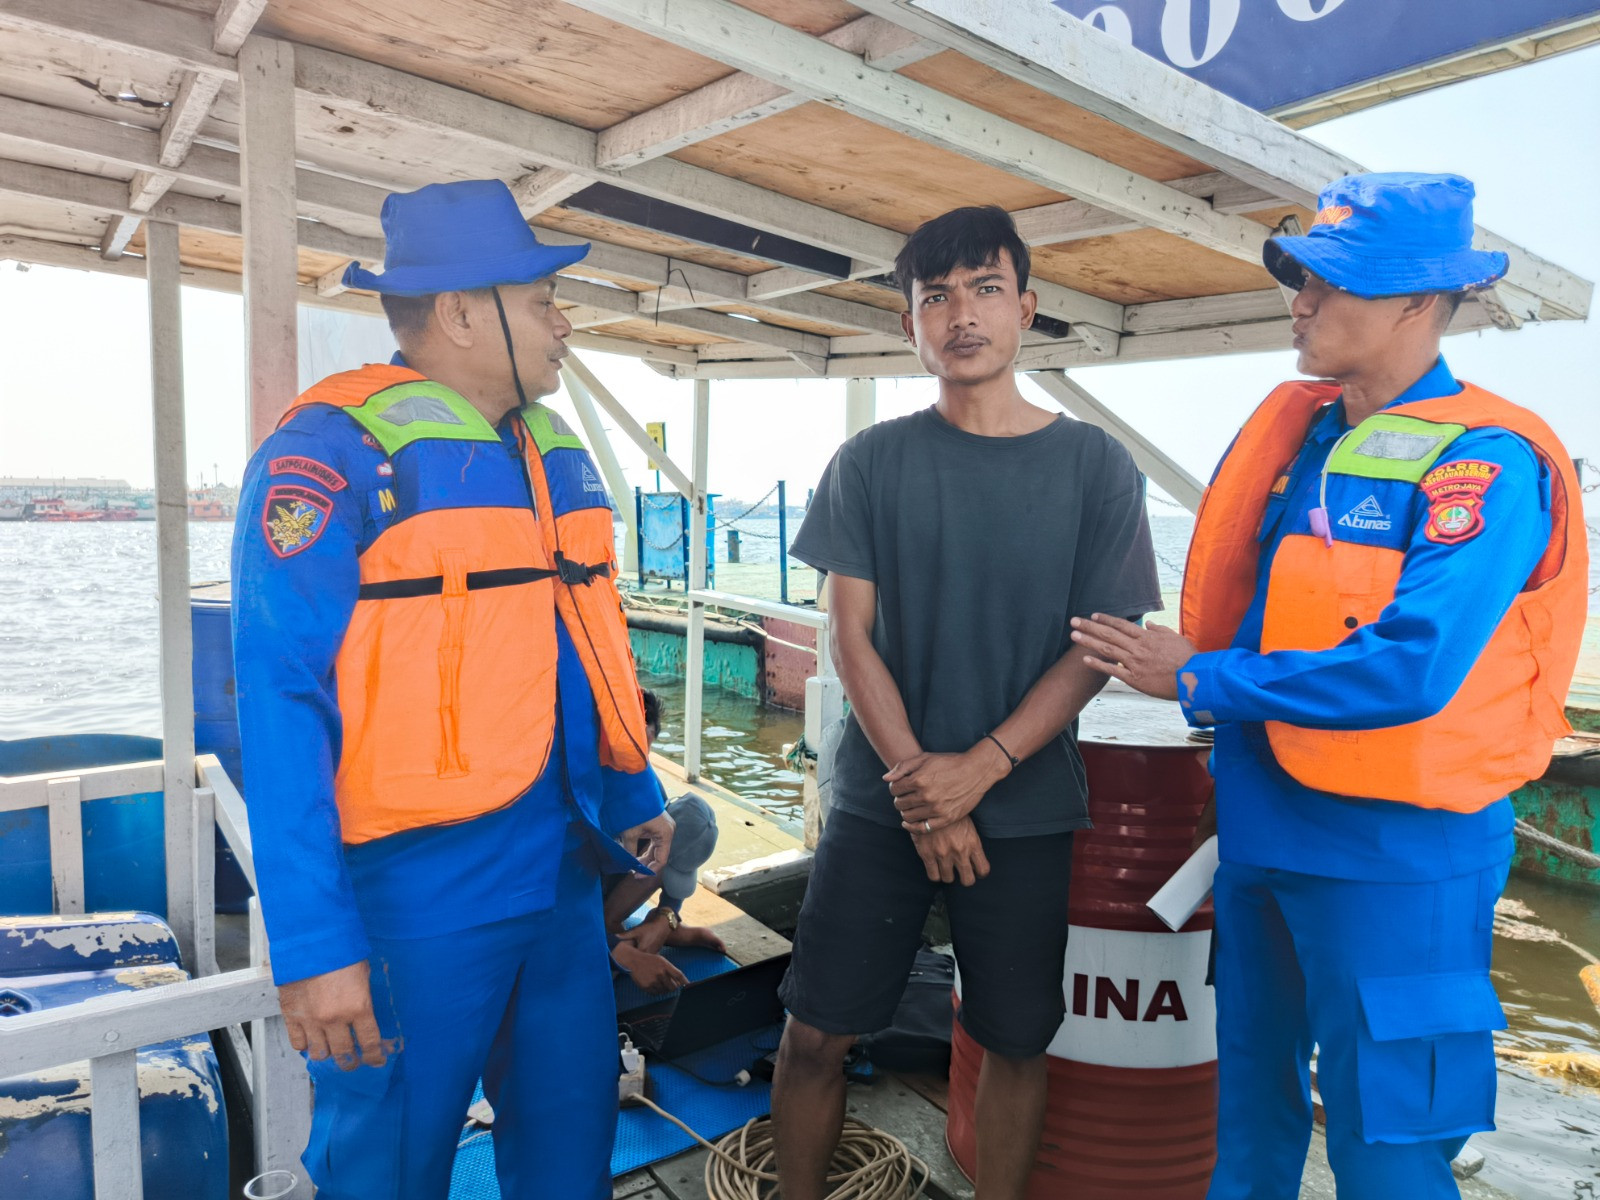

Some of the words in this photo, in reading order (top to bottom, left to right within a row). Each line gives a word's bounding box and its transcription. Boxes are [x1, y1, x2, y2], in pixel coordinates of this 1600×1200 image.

[1425, 462, 1490, 484] POLRES
[1431, 484, 1461, 496] METRO
[1461, 483, 1482, 491] JAYA
[1337, 513, 1392, 531] Atunas
[1063, 973, 1188, 1022] INA
